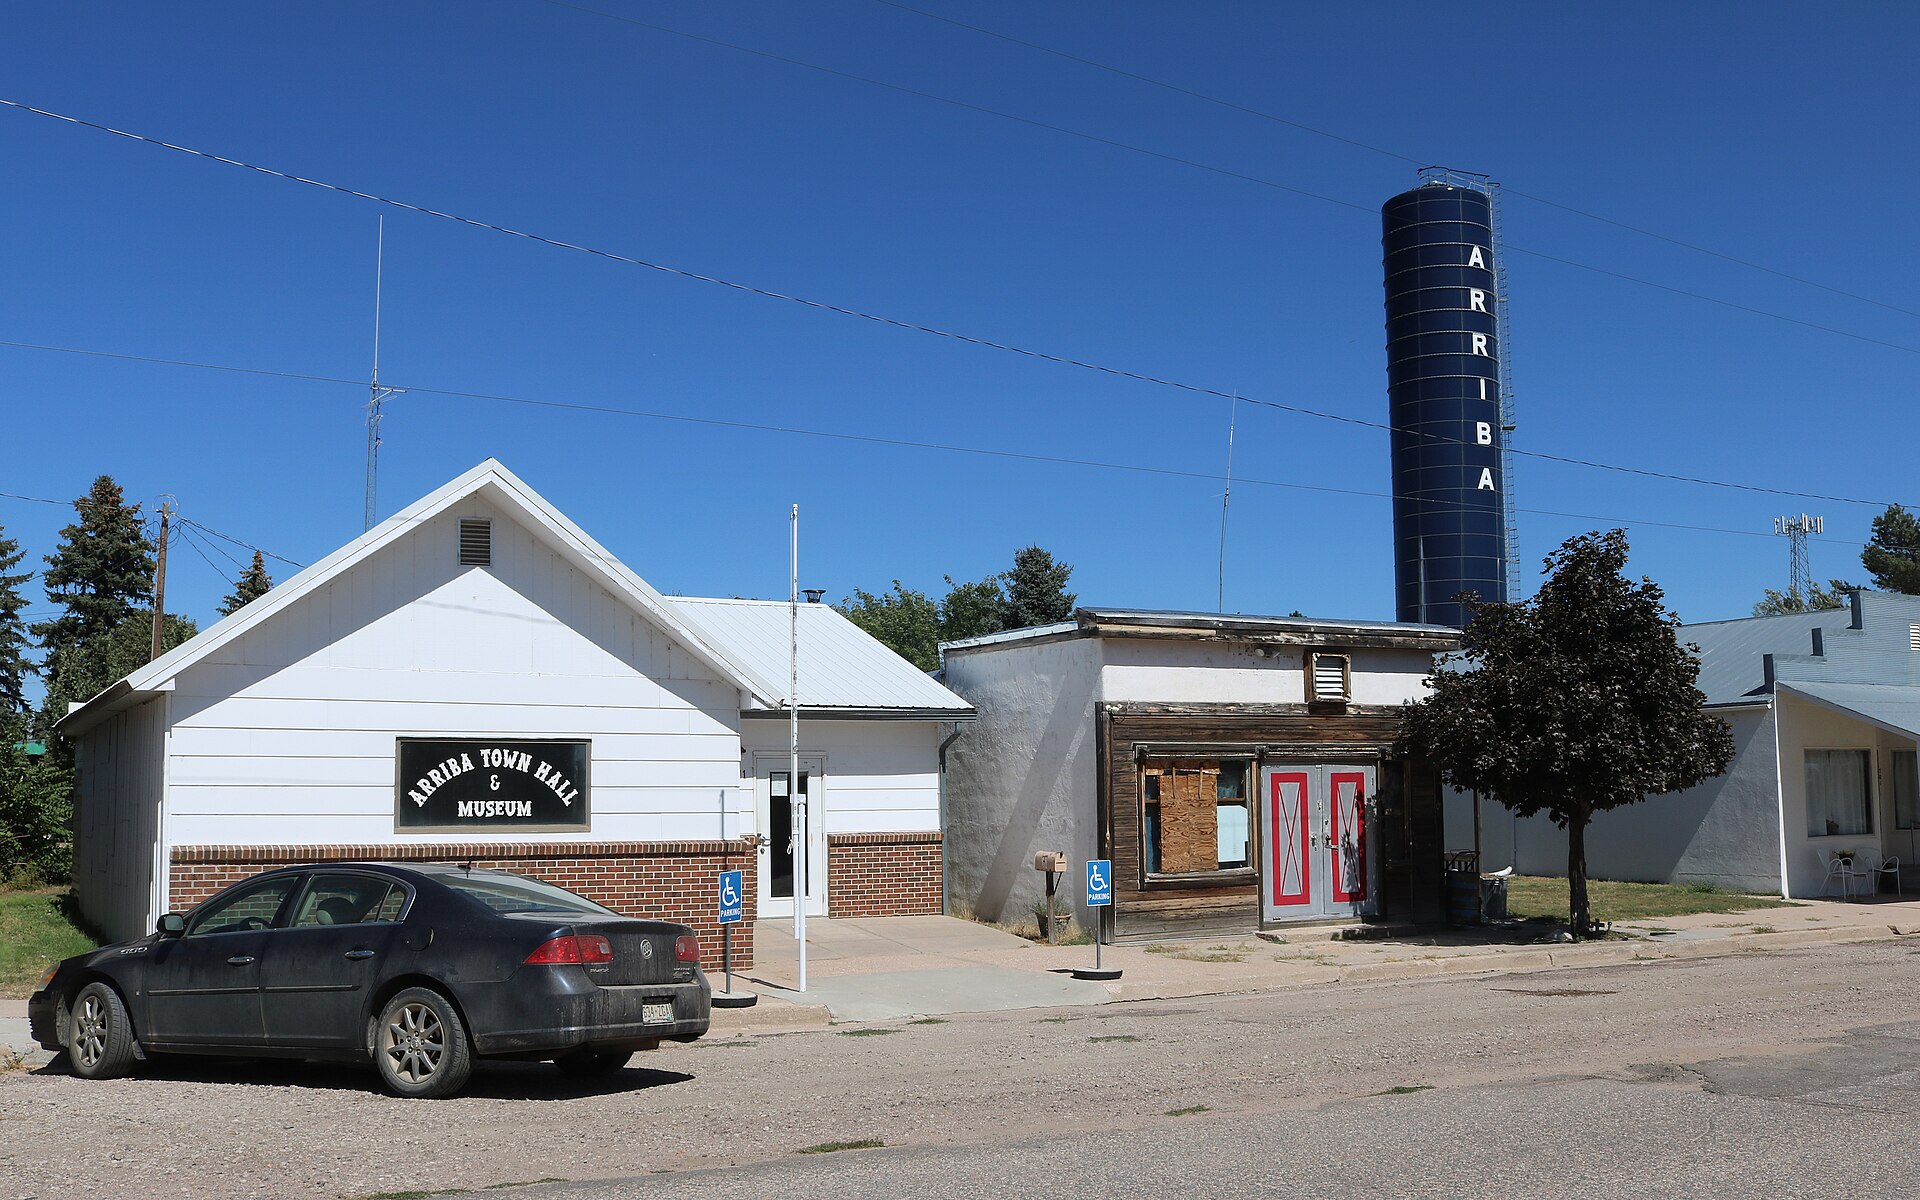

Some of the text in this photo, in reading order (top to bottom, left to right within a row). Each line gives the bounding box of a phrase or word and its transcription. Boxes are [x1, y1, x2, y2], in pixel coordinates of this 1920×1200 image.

[1467, 244, 1495, 491] ARRIBA
[407, 748, 579, 807] ARRIBA TOWN HALL
[490, 774, 501, 791] &
[457, 800, 532, 818] MUSEUM
[1088, 893, 1110, 901] PARKING
[720, 908, 740, 917] PARKING
